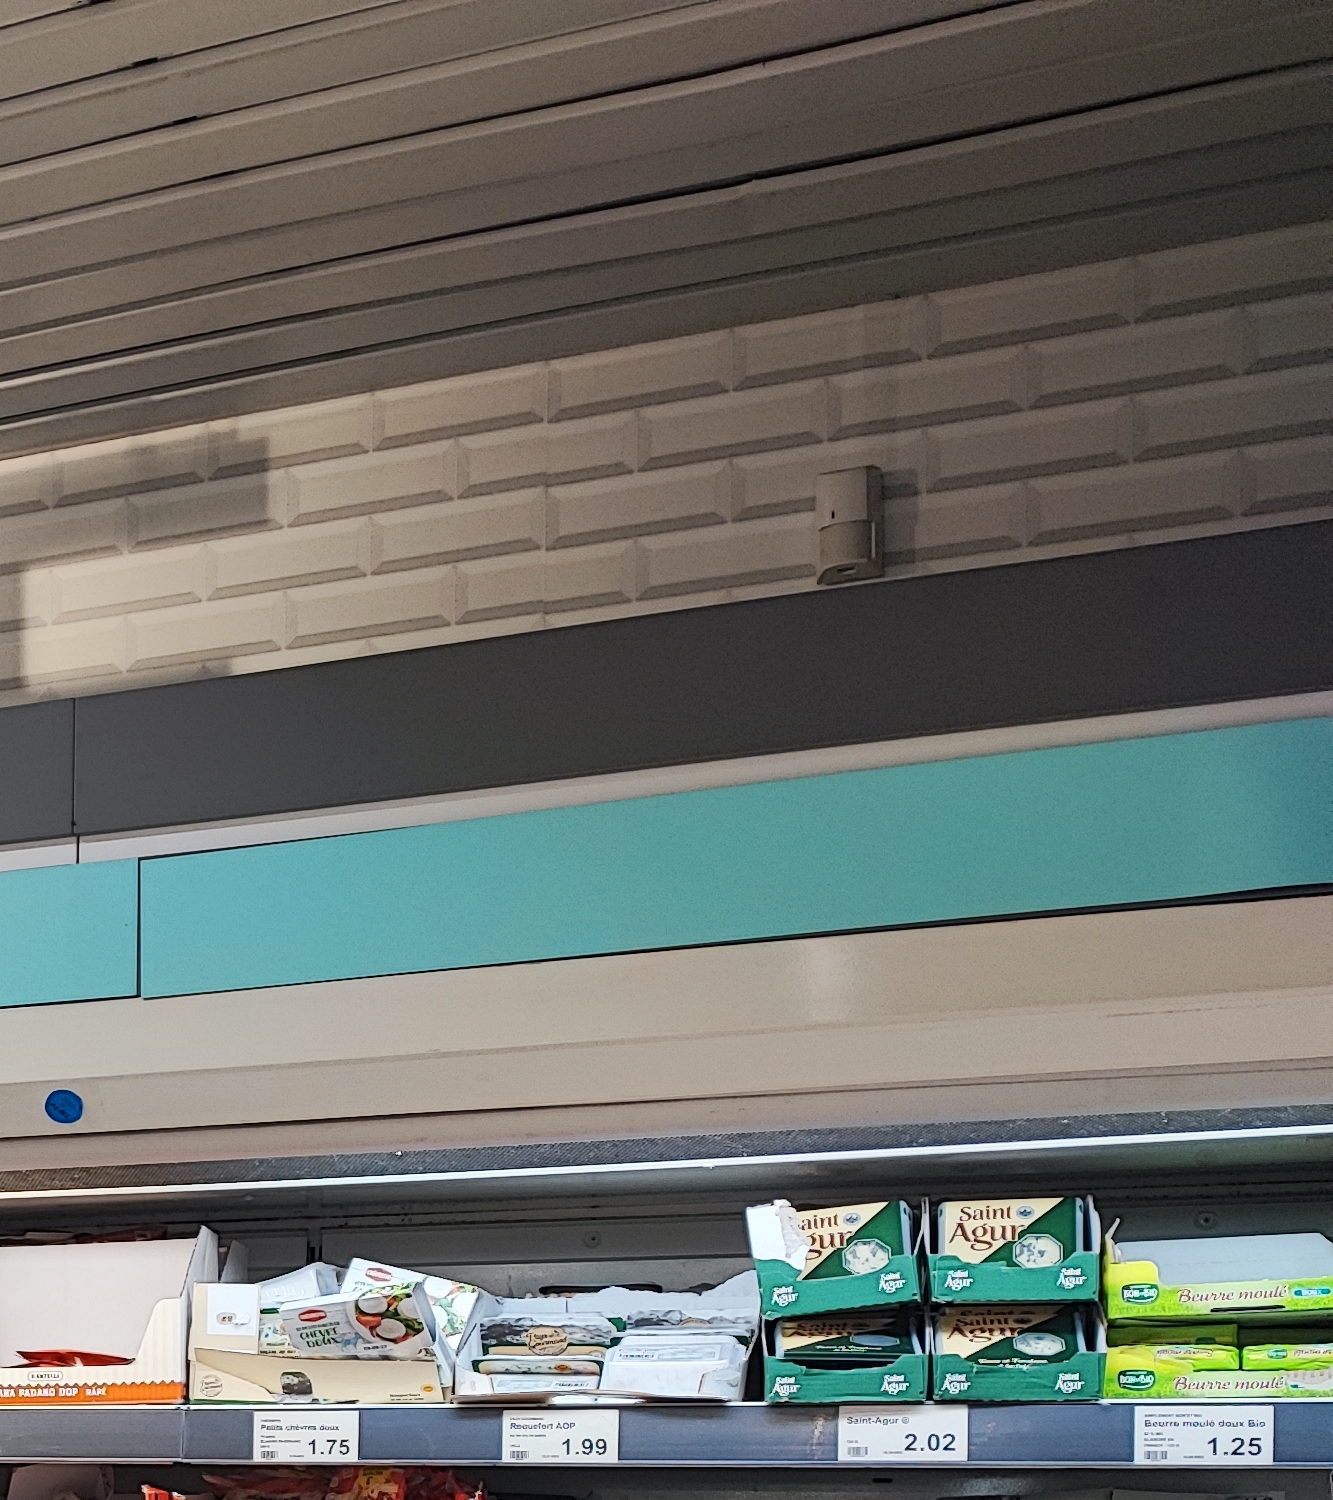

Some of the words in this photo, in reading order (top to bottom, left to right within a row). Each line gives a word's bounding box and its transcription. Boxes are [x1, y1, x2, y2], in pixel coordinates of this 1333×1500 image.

[960, 1206, 1011, 1221] Saint
[949, 1221, 1022, 1251] Agur
[19, 1388, 55, 1397] PADANO
[59, 1388, 79, 1397] DOP
[308, 1438, 349, 1456] 1.75
[562, 1438, 607, 1456] 1.99
[904, 1433, 956, 1453] 2.02
[1207, 1437, 1263, 1456] 1.25
